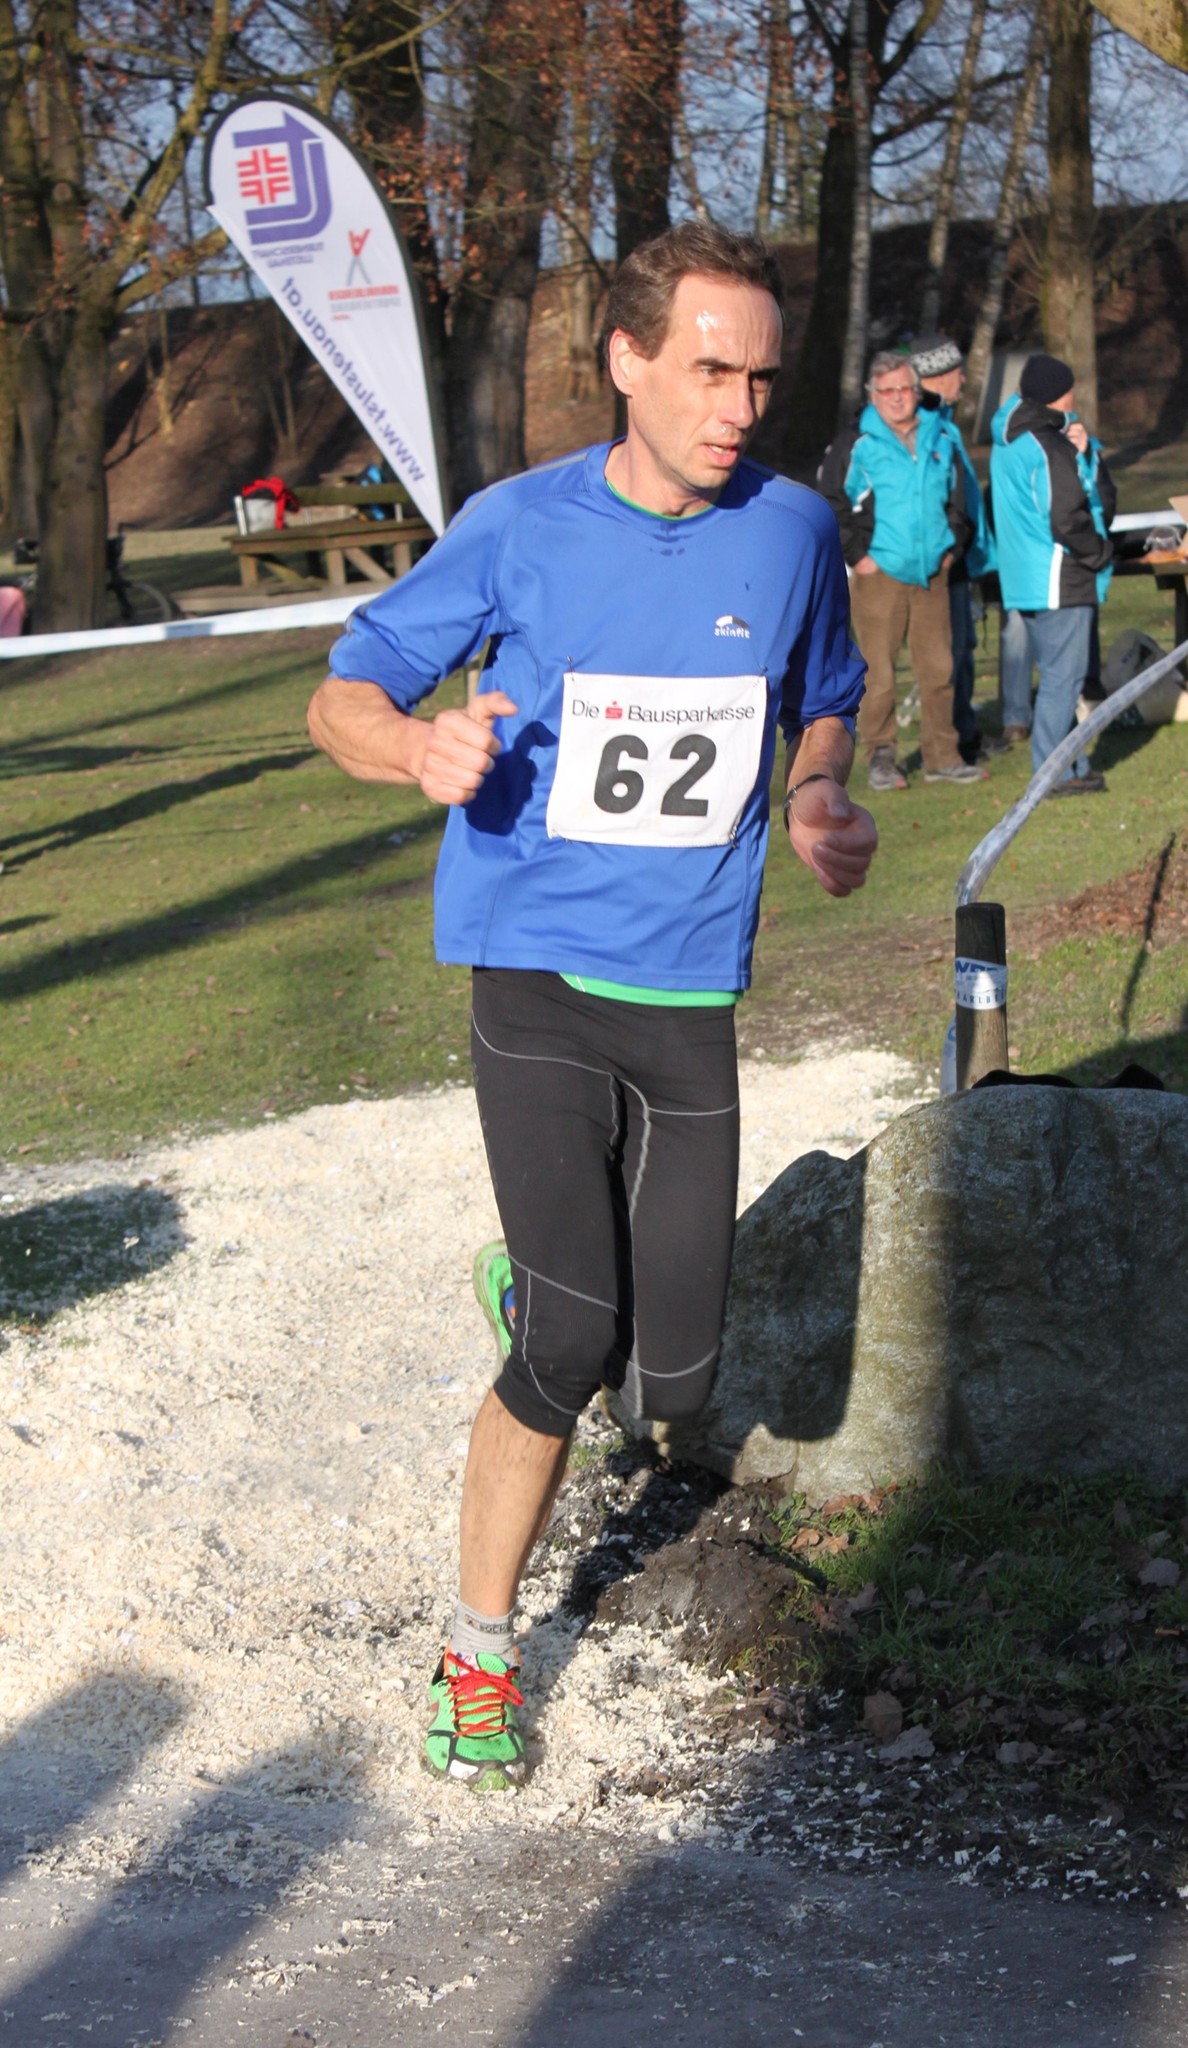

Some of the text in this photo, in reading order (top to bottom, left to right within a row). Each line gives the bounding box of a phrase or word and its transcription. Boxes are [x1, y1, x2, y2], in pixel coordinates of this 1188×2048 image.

[714, 626, 751, 639] skinfit
[572, 699, 755, 725] Die Bausparkasse
[594, 734, 717, 817] 62
